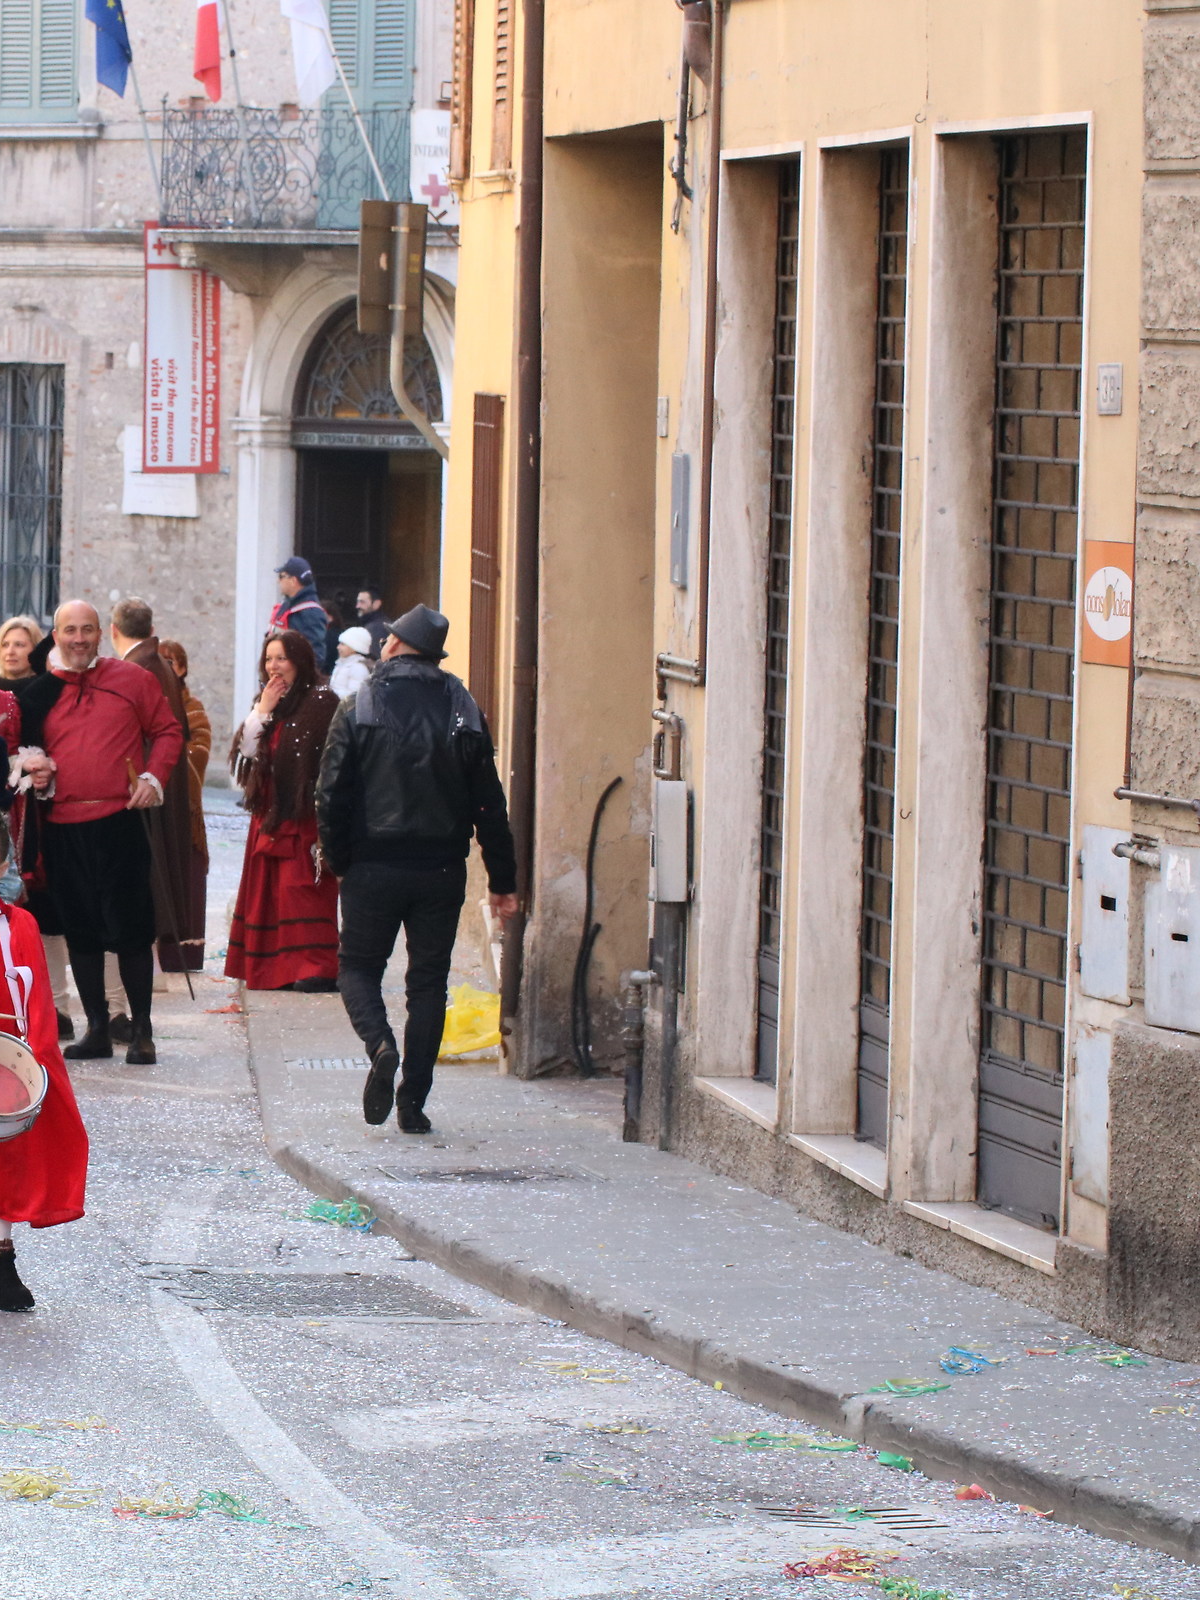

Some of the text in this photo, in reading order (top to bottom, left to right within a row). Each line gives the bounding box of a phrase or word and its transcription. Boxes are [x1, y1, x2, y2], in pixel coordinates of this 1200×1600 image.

[190, 273, 200, 462] International Museum of the Red Cross
[205, 360, 216, 391] della
[1102, 375, 1115, 403] 38
[150, 358, 163, 462] visita il museo
[166, 359, 178, 462] visit the museum
[205, 393, 216, 424] Croce
[205, 427, 216, 462] Rossa
